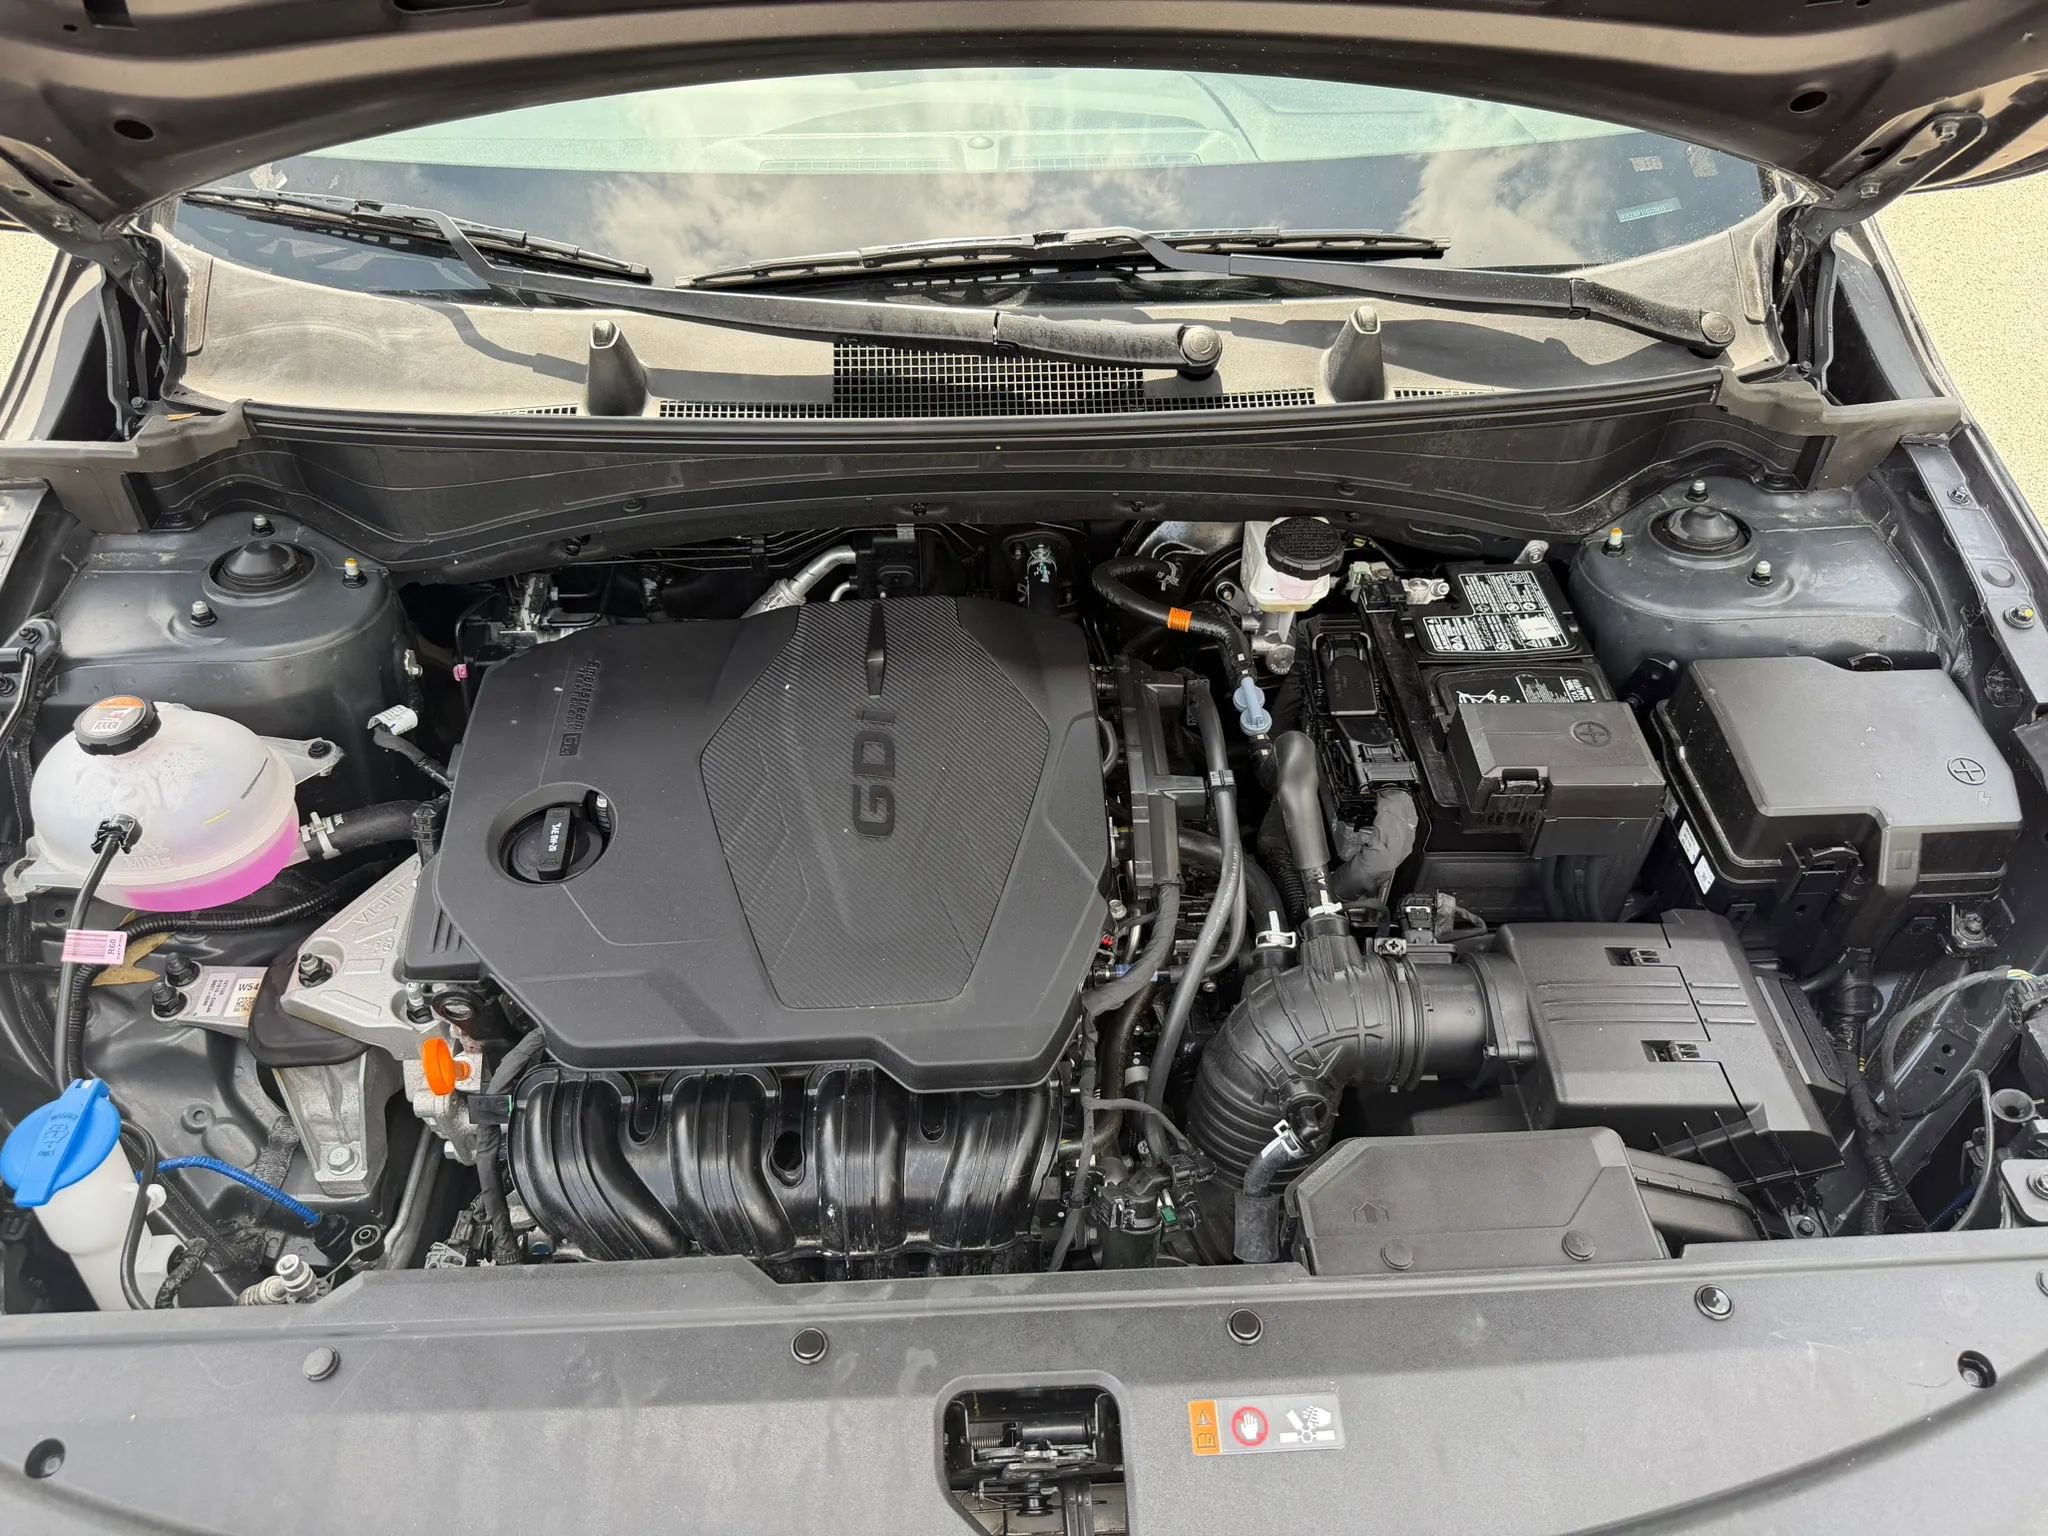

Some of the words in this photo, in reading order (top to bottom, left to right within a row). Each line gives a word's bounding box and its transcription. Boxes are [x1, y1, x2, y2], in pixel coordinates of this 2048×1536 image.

[573, 659, 600, 730] Smartstream
[852, 709, 896, 838] GDI
[551, 822, 562, 834] SAE
[107, 938, 117, 956] R60
[238, 982, 260, 992] W54
